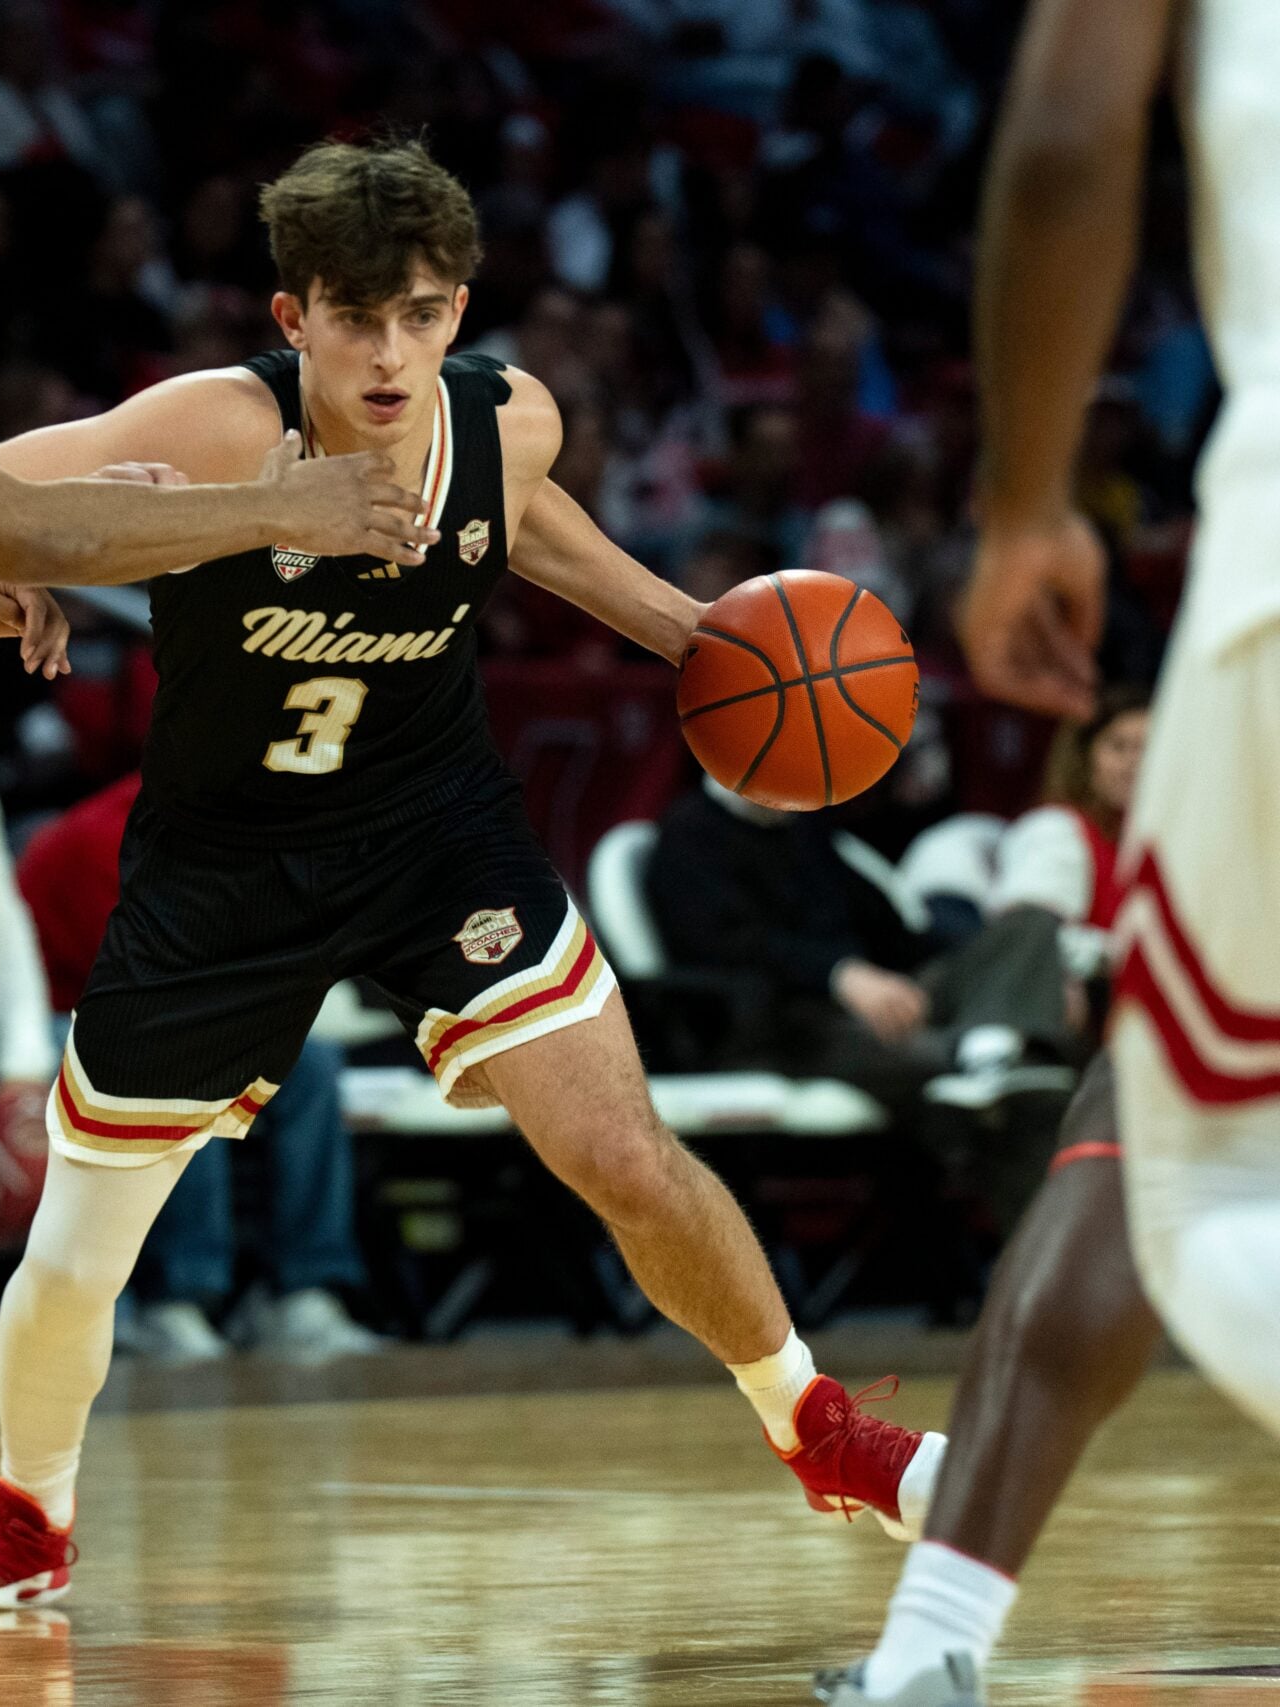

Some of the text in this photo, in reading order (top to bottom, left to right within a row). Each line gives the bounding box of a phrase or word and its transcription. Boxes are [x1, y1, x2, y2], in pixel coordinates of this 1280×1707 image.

[272, 552, 316, 568] MAC
[242, 603, 470, 664] Miami
[261, 676, 369, 775] 3
[471, 916, 492, 930] MIAMI
[470, 926, 518, 949] COACHES
